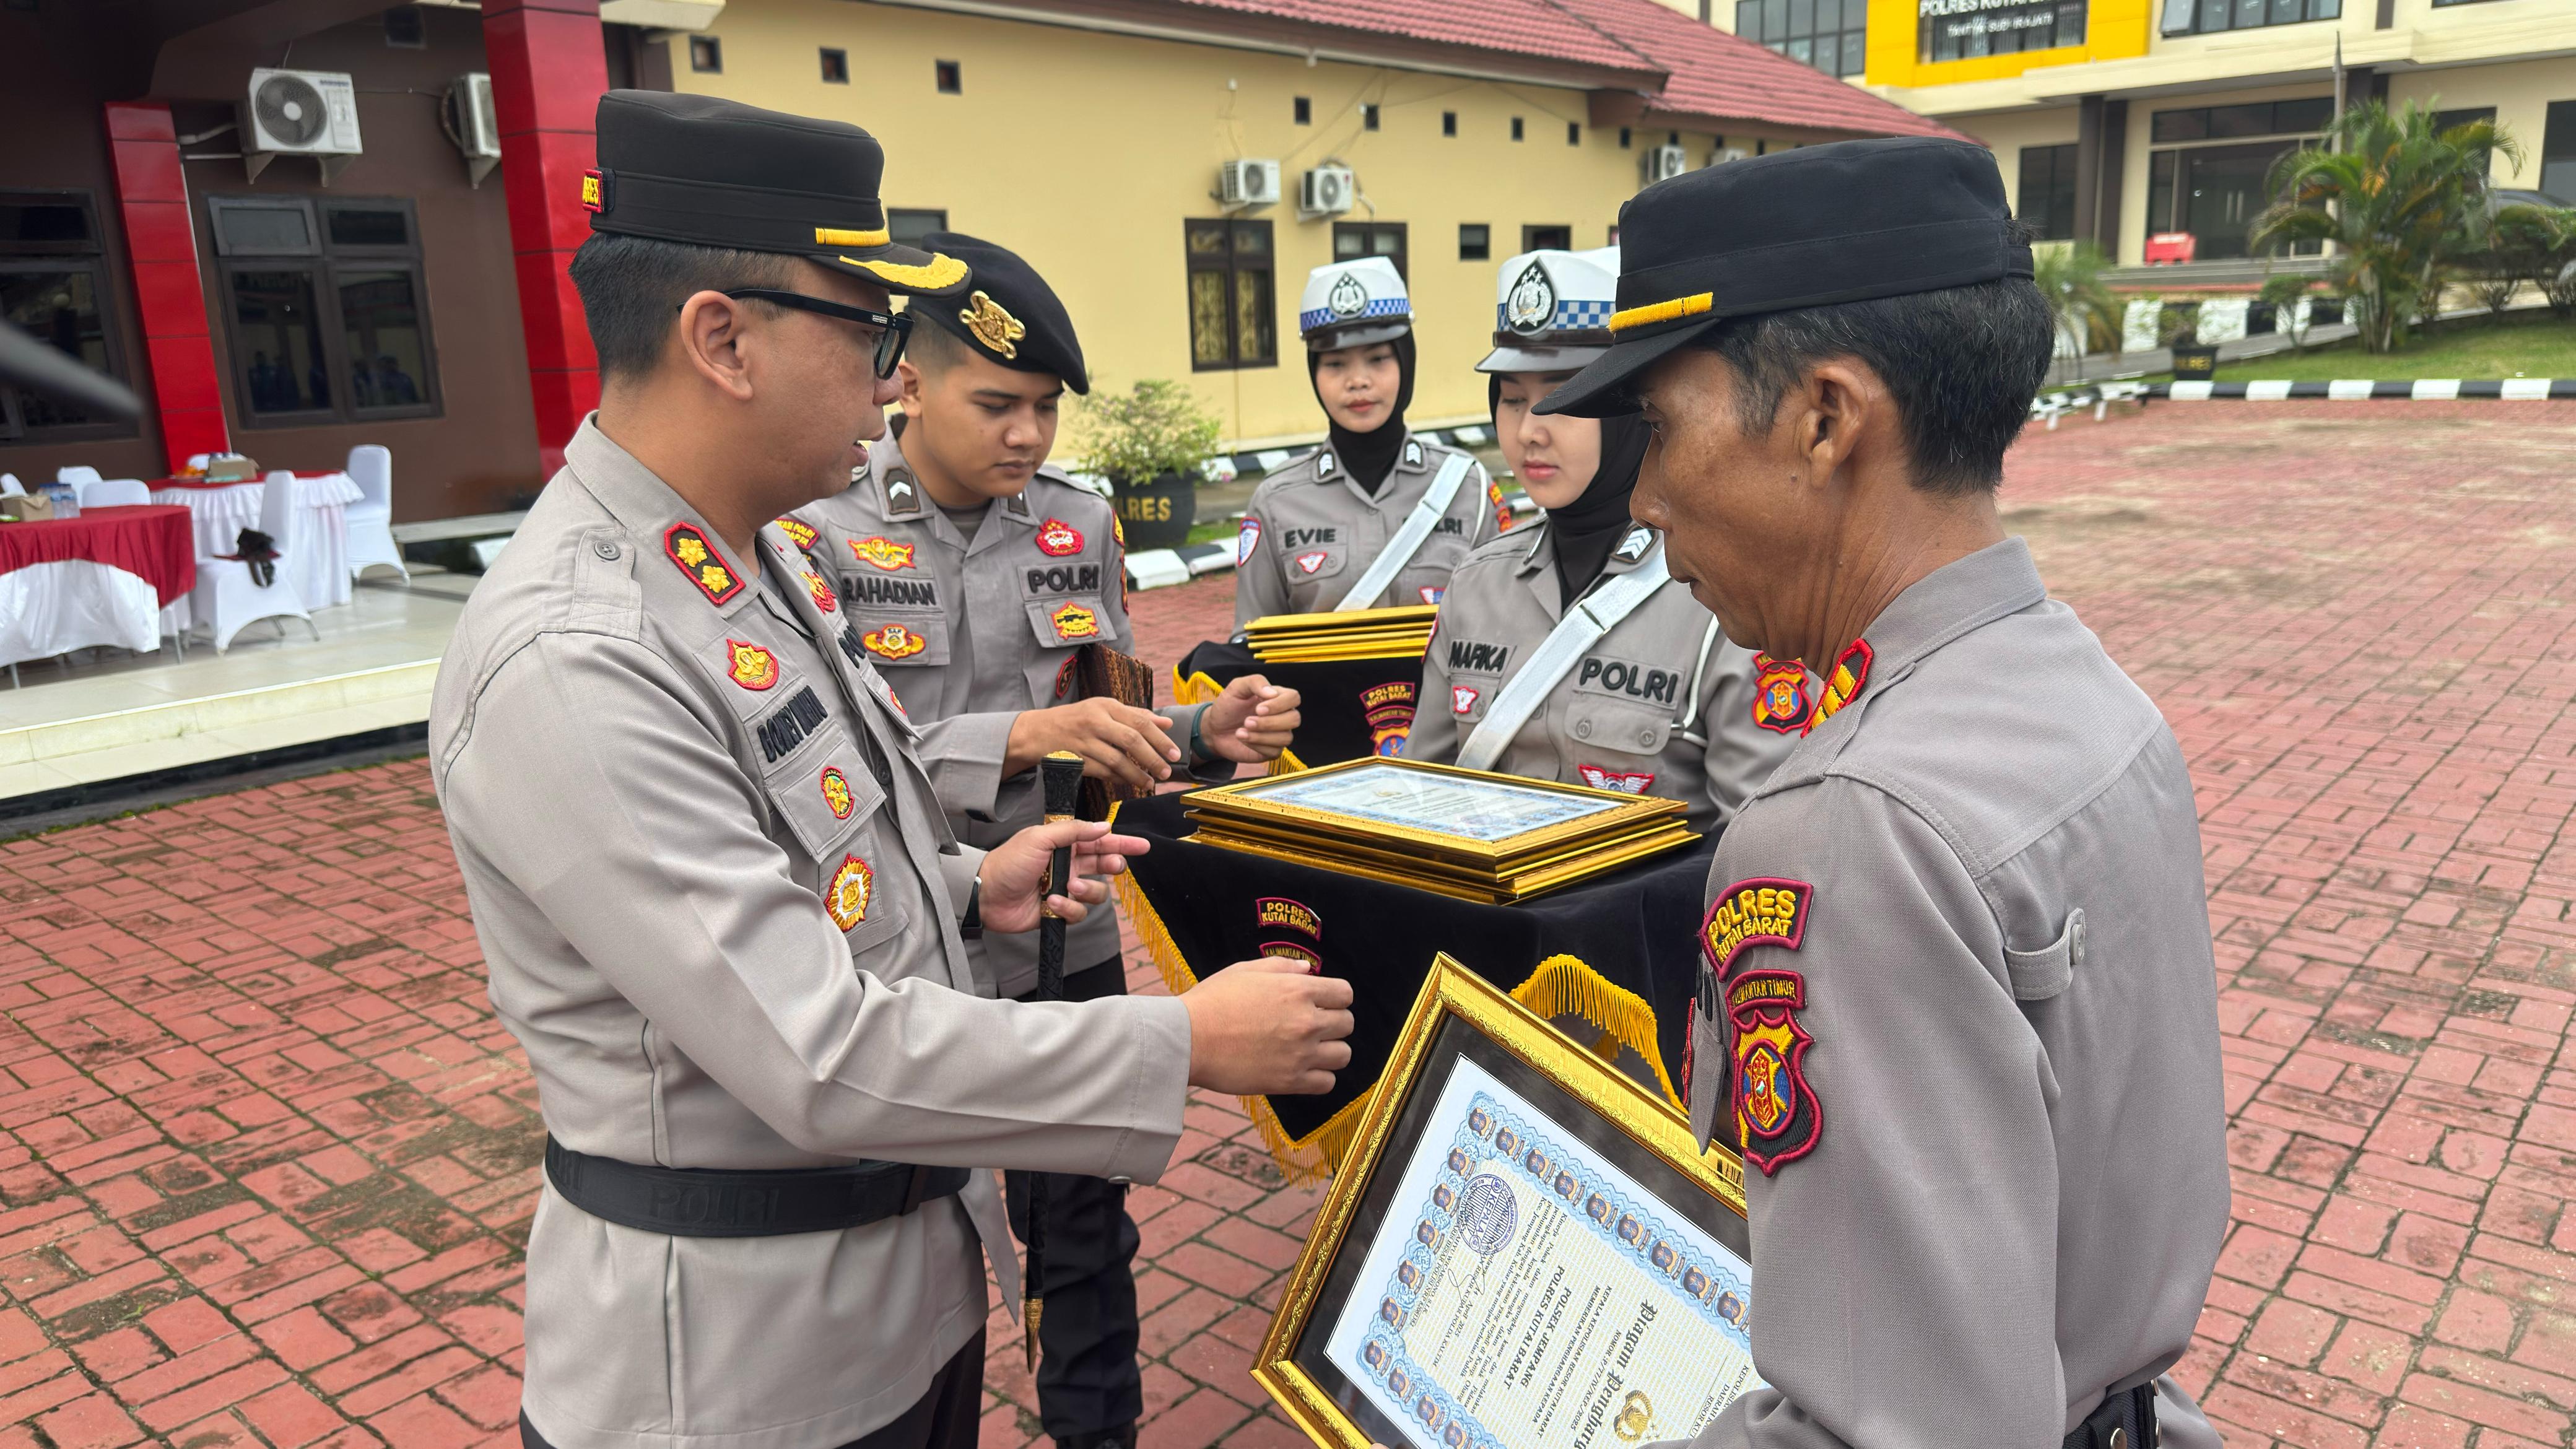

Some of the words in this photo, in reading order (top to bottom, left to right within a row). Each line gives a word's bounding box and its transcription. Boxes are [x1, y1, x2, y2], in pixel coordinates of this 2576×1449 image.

[1285, 528, 1336, 549] EVIE
[843, 577, 936, 606] RAHADIAN
[1027, 565, 1099, 593] POLRI
[1368, 685, 1406, 698] POLRES
[1580, 658, 1679, 703] POLRI
[1262, 912, 1287, 922] KUTAI
[1290, 915, 1317, 934] BARAT
[1267, 902, 1312, 922] POLRES
[1708, 888, 1796, 951] POLRES
[1716, 925, 1744, 964] KUTAI
[1743, 916, 1792, 937] BARAT
[1767, 978, 1796, 999] TIMUR
[1473, 1192, 1499, 1235] KEPALA
[1535, 1195, 1547, 1214] Kec.
[1520, 1211, 1539, 1243] Jempang
[1528, 1199, 1554, 1247] pembunuhan
[1535, 1205, 1560, 1251] penangkapan
[1551, 1211, 1568, 1238] Kinerja
[1438, 1238, 1452, 1263] BESAR
[1514, 1242, 1525, 1260] Kab.
[1516, 1245, 1533, 1272] dengan
[1539, 1241, 1554, 1265] Polsek
[1427, 1261, 1442, 1287] POLISI
[1467, 1264, 1482, 1290] RESOR
[1503, 1258, 1518, 1282] Kubar
[1521, 1256, 1537, 1282] kepada
[1528, 1267, 1542, 1290] dalam
[1421, 1284, 1431, 1302] NRP
[1495, 1278, 1507, 1297] yang
[1502, 1272, 1521, 1305] kekerasan
[1539, 1264, 1565, 1311] POLRES
[1593, 1284, 1612, 1318] KEPALA
[1455, 1288, 1471, 1315] KUBAR
[1461, 1299, 1474, 1320] April
[1483, 1296, 1500, 1325] menjadi
[1493, 1304, 1504, 1323] yang
[1503, 1287, 1523, 1320] tersangka
[1505, 1291, 1530, 1336] mengungkap
[1545, 1286, 1573, 1334] POLSEK
[1573, 1285, 1601, 1336] MEMBERIKAN
[1444, 1313, 1460, 1339] POLDA
[1453, 1319, 1465, 1338] 2025
[1469, 1323, 1488, 1356] perhatian
[1482, 1322, 1497, 1346] terjadi
[1491, 1325, 1505, 1347] dalam
[1521, 1308, 1544, 1347] KUTAI
[1572, 1316, 1598, 1363] KEPOLISIAN
[1612, 1297, 1659, 1373] Piagam
[1431, 1338, 1448, 1368] KALTIM
[1479, 1345, 1486, 1355] di
[1495, 1338, 1508, 1359] kasus
[1604, 1328, 1622, 1358] NOMOR
[1459, 1354, 1473, 1379] Publik
[1467, 1354, 1482, 1379] Kamp.
[1477, 1353, 1492, 1379] Tindak
[1488, 1360, 1498, 1376] dan
[1502, 1345, 1528, 1390] BARAT
[1519, 1331, 1551, 1388] JEMPANG
[1546, 1334, 1578, 1393] PENGHARGAAN
[1560, 1360, 1577, 1388] RESOR
[1463, 1384, 1477, 1409] Pidana
[1469, 1378, 1490, 1416] melakukan
[1549, 1385, 1565, 1411] KUTAI
[1708, 1383, 1730, 1417] DAERAH
[1721, 1364, 1750, 1413] KEPOLISIA
[1531, 1391, 1550, 1424] KEPADA
[1571, 1366, 1625, 1449] Pengharg
[1697, 1394, 1714, 1422] RESOR
[1536, 1409, 1553, 1439] BARAT
[1687, 1420, 1702, 1442] KUT
